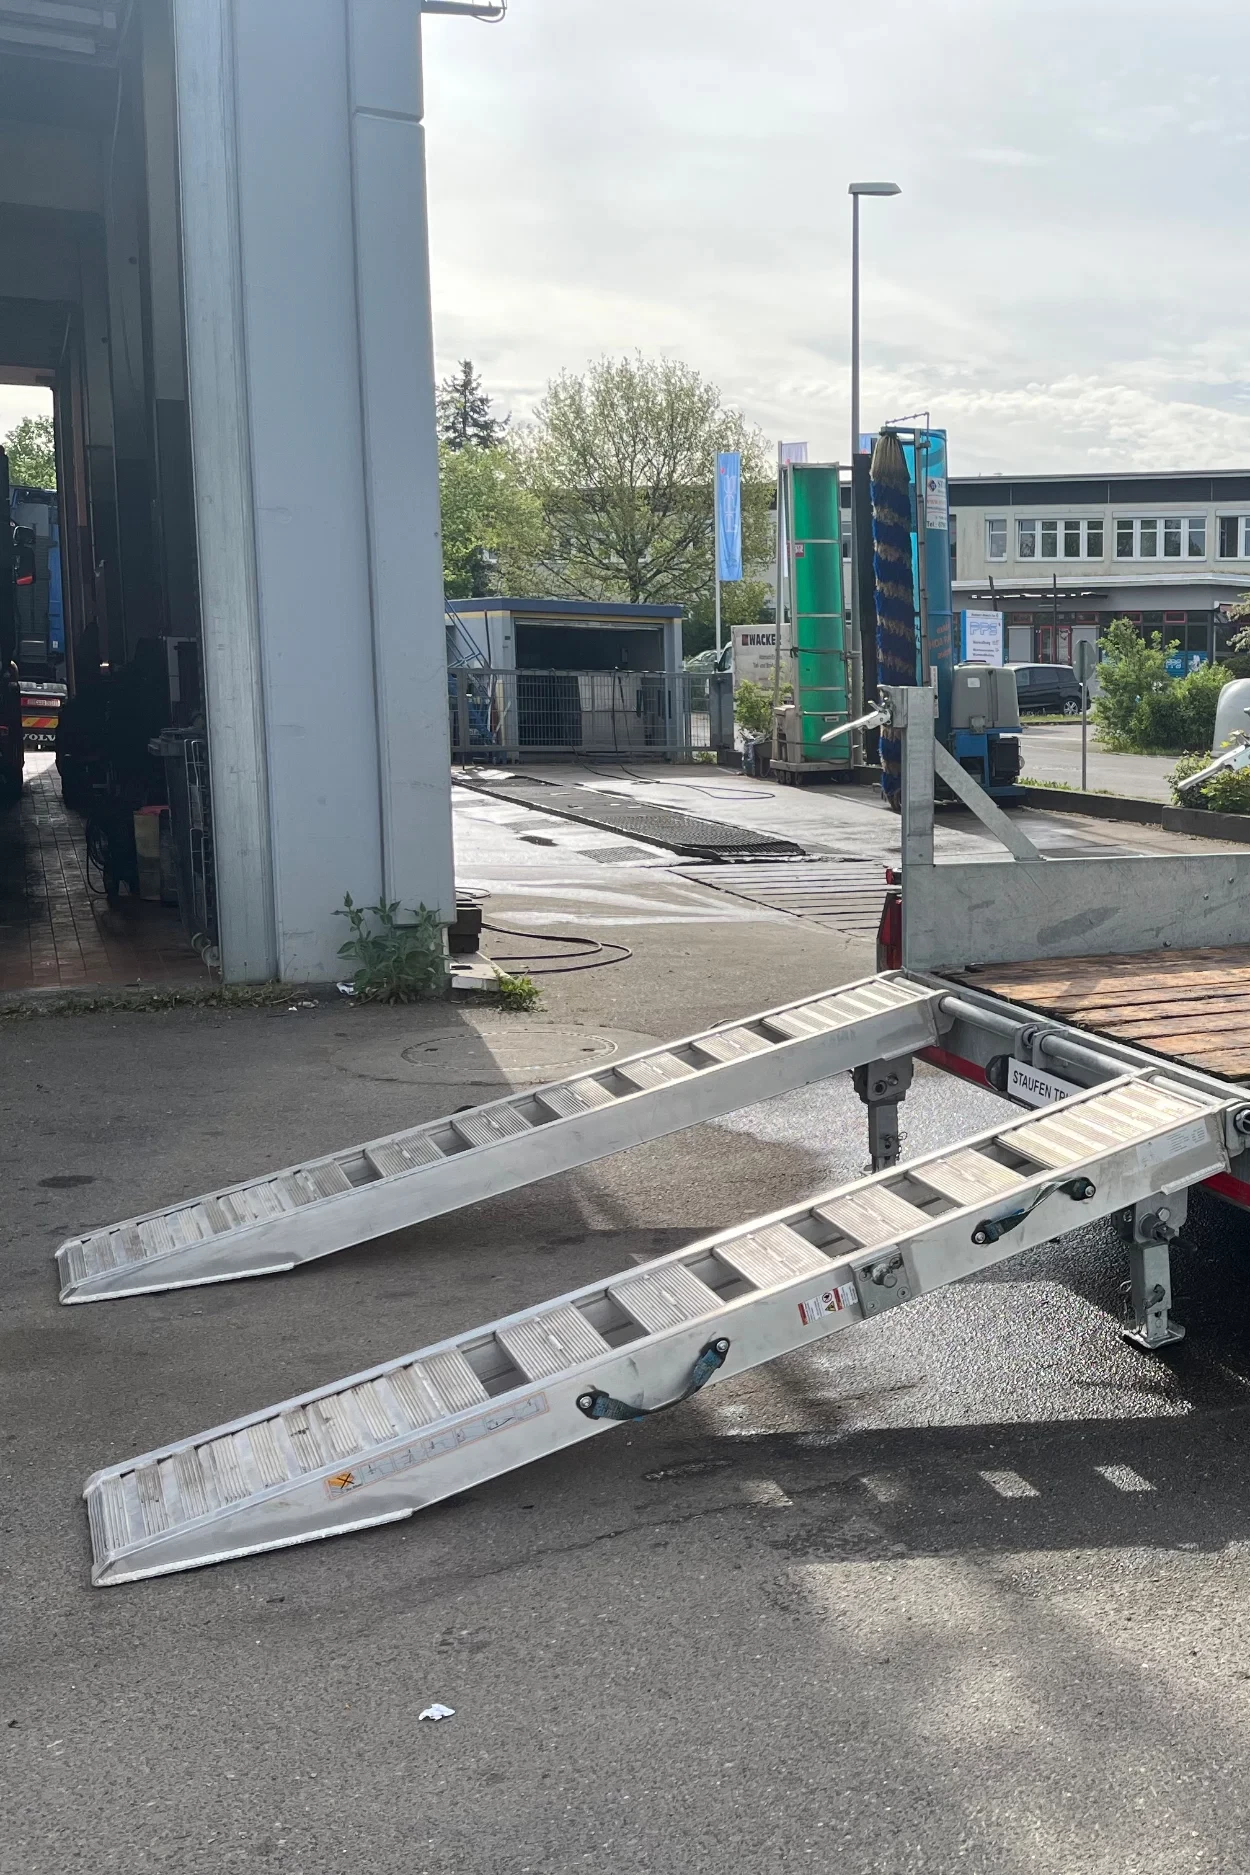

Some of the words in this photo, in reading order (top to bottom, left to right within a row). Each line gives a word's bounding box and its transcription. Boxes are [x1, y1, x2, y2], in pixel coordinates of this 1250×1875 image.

[970, 621, 998, 636] PPS
[1012, 1070, 1052, 1099] STAUFEN
[1054, 1087, 1072, 1102] TR
